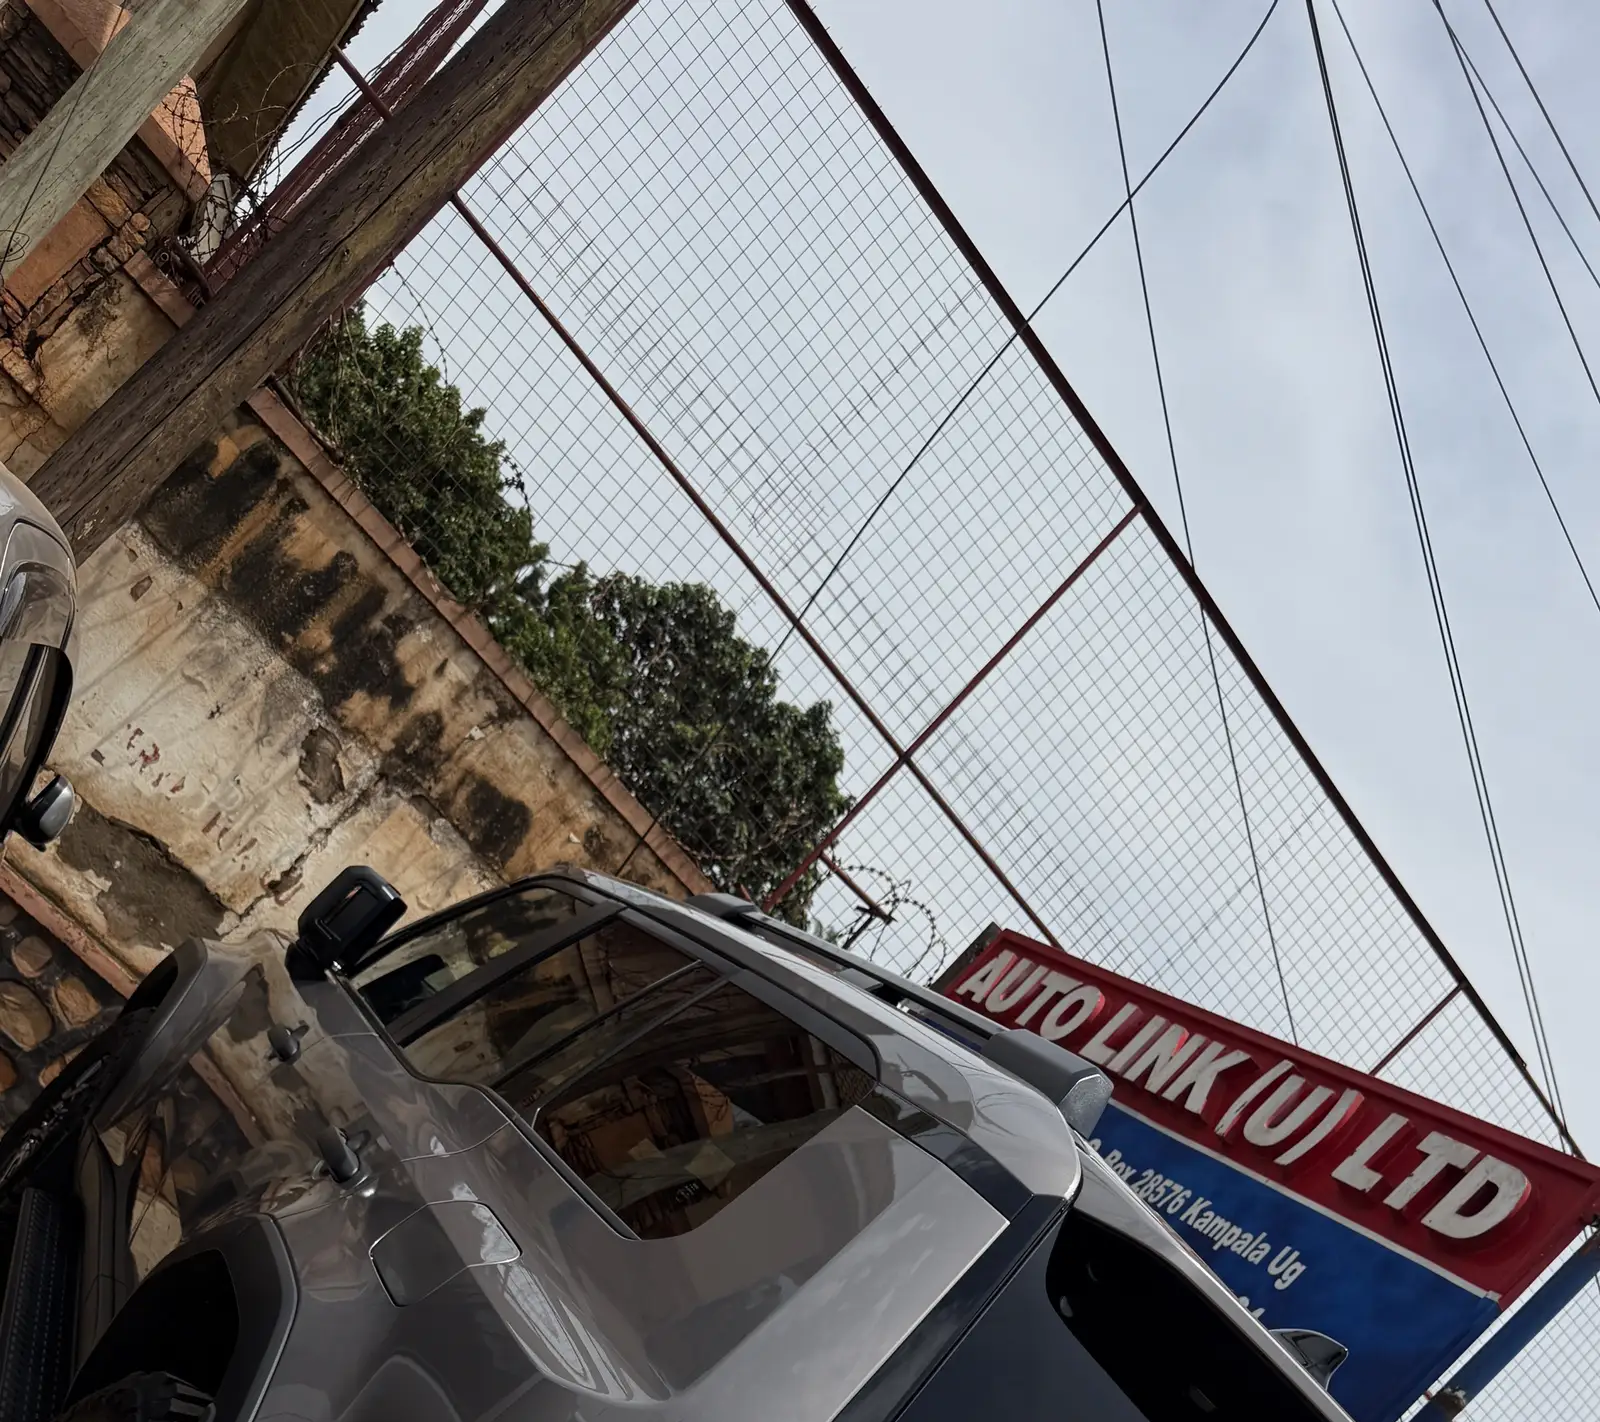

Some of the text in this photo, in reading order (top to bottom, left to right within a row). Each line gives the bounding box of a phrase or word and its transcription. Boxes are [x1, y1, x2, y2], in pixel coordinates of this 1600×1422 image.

[955, 949, 1531, 1239] AUTO LINK (U) LTD
[1130, 1168, 1193, 1214] 28576
[1179, 1196, 1272, 1266] Kampala
[1267, 1245, 1308, 1290] Ug
